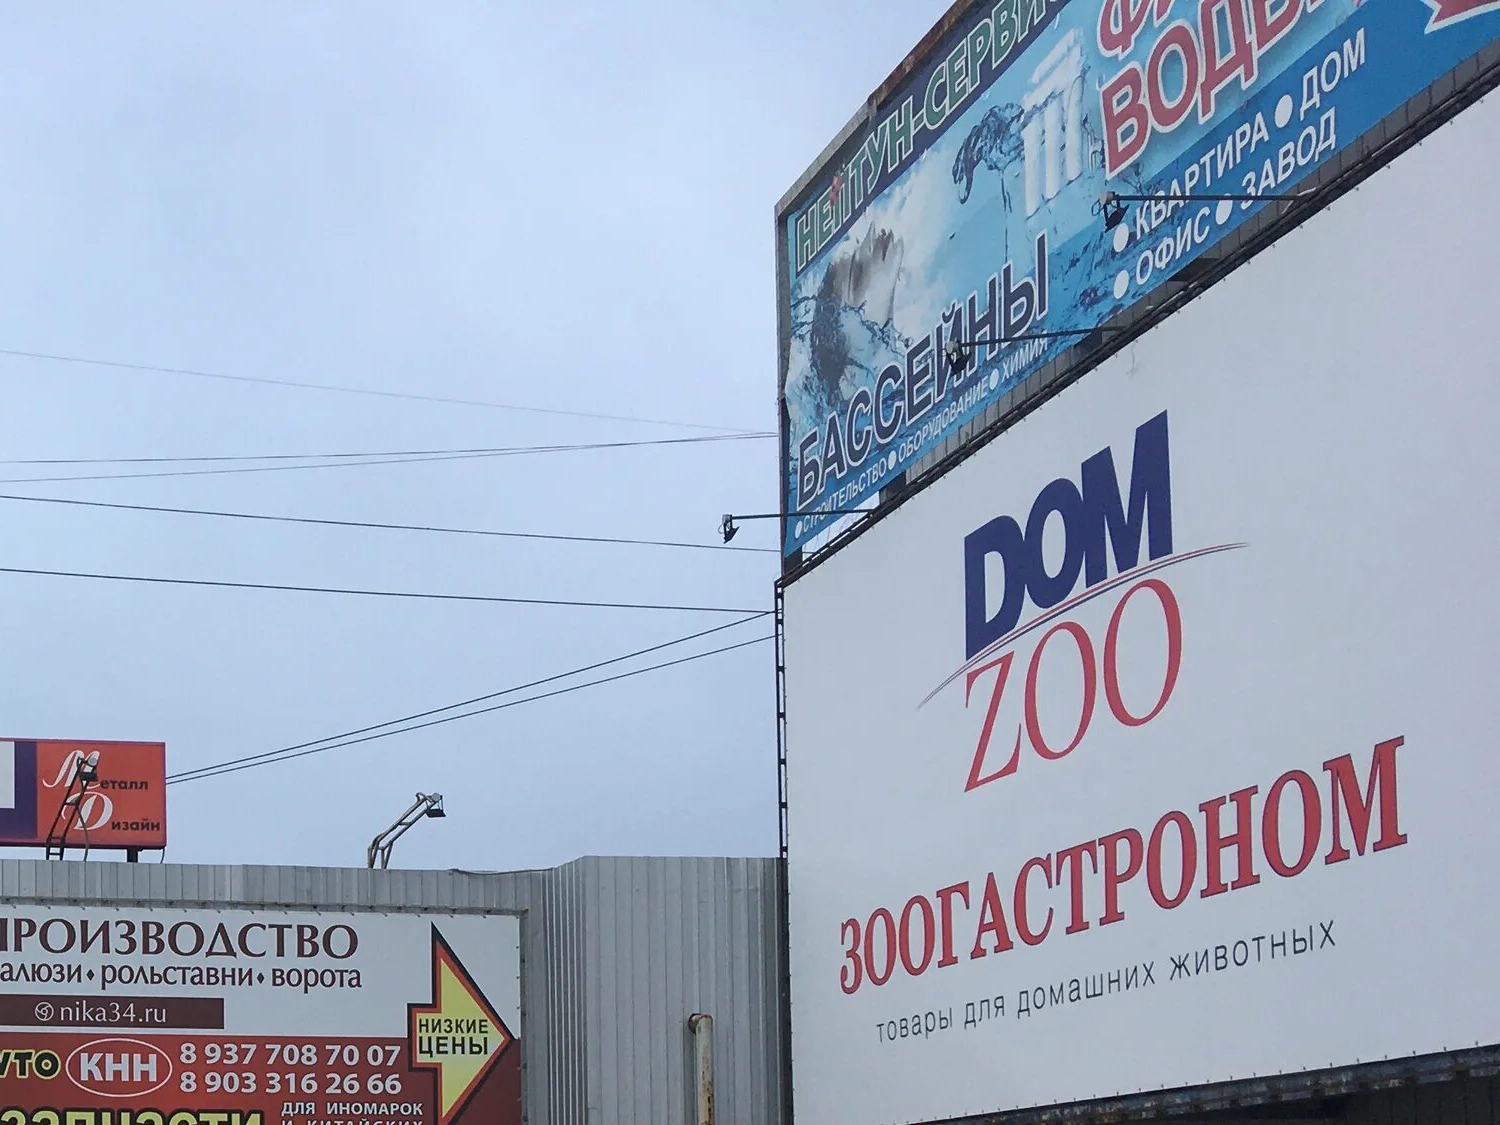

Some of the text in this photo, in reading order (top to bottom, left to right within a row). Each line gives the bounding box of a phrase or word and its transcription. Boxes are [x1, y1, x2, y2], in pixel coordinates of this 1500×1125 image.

[1136, 112, 1270, 241] КВАРТИРА
[1299, 28, 1366, 120] ДОМ
[1136, 106, 1337, 286] ОФИС ЗАВОД
[797, 229, 1050, 511] БАССЕЙНЫ
[803, 337, 1049, 533] СТРОИТЕЛЬСТВО ОБОРУДОВАНИЕ ХИМИЯ
[964, 409, 1173, 662] DOM
[964, 579, 1182, 793] ZOO
[839, 735, 1407, 995] ЗООГАСТРОНОМ
[60, 1001, 167, 1023] nika34.ru
[101, 964, 253, 990] рольставни
[271, 967, 363, 994] ворота
[418, 1018, 488, 1034] НИЗКИЕ
[876, 920, 1336, 1044] товары для домашних животных
[180, 1043, 401, 1066] 8 937 708 70 07
[180, 1072, 402, 1095] 8 903 316 26 66
[418, 1036, 488, 1057] ЦЕНЫ
[281, 1102, 424, 1117] ДЛЯ ИНОМАРОК
